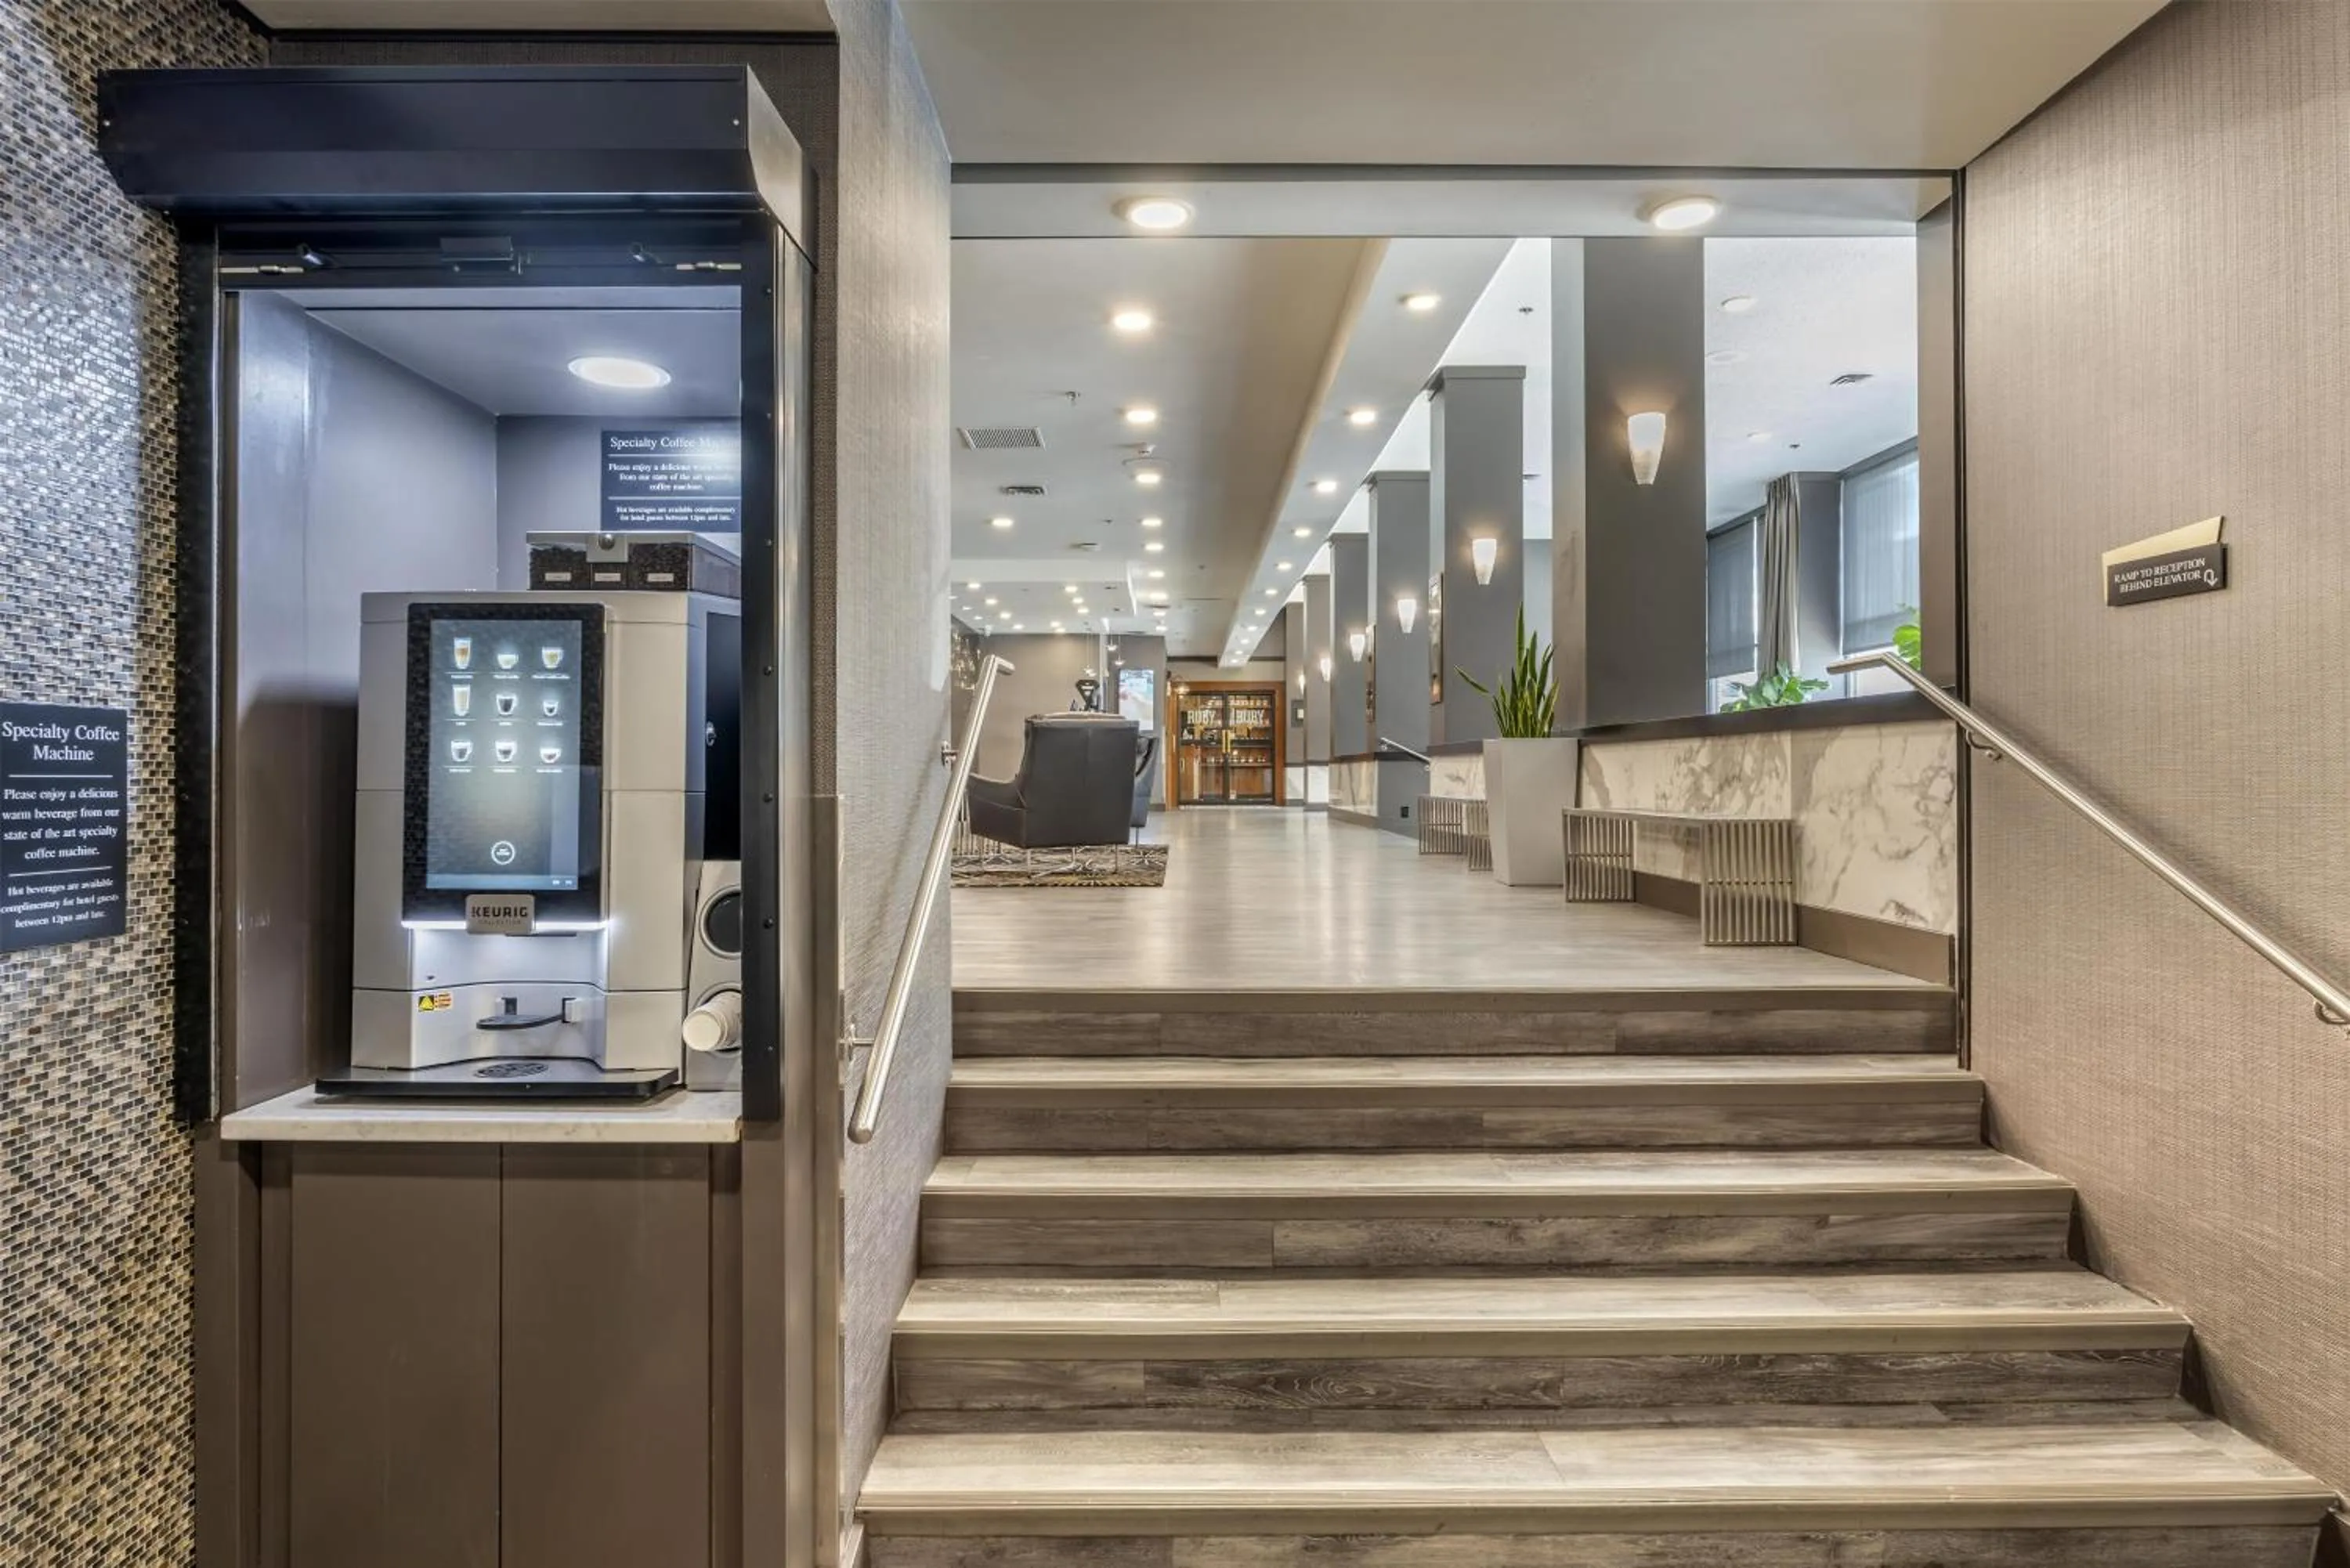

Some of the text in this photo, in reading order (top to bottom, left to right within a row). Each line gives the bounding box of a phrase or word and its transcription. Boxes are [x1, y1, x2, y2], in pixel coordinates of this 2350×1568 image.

[610, 437, 657, 450] Specialty
[660, 437, 695, 448] Coffee
[2114, 558, 2206, 583] RAMP TO RECEPTION
[2120, 569, 2201, 594] BEHIND ELEVATOR
[2, 721, 120, 743] Specialty Coffee
[33, 744, 94, 761] Machine
[3, 787, 118, 801] Please enjoy a delicious
[2, 811, 31, 820] warm
[34, 808, 78, 821] beverage
[81, 807, 102, 817] from
[3, 825, 118, 840] state of the art specialty
[24, 845, 100, 859] coffee machine.
[471, 906, 527, 917] KEURIG
[15, 917, 49, 928] between
